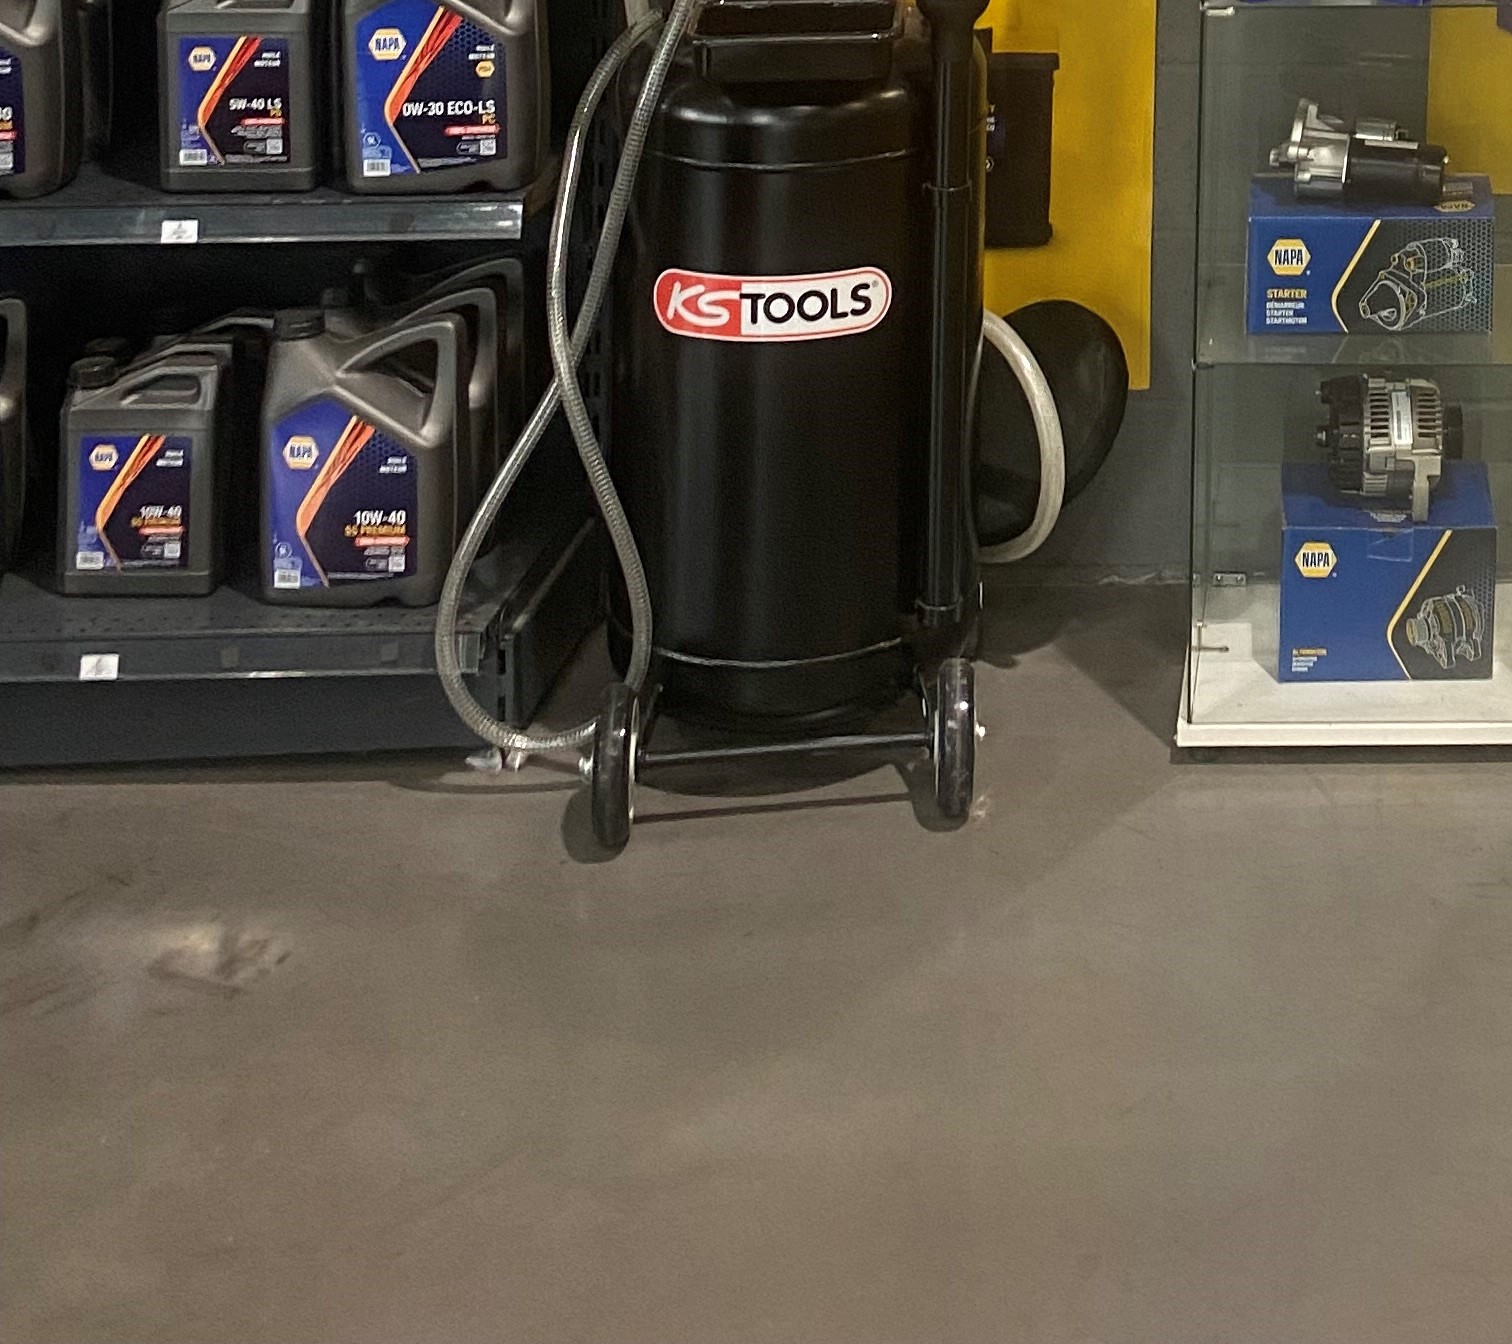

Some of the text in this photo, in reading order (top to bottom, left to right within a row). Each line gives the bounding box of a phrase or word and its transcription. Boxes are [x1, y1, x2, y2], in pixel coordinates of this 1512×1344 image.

[402, 100, 496, 117] 0W-30 ECO-LS
[1274, 249, 1305, 267] NAPA
[1266, 288, 1307, 299] STARTER
[667, 281, 871, 327] KS TOOLS
[353, 509, 407, 526] 10W-40
[1302, 551, 1330, 568] NAPA
